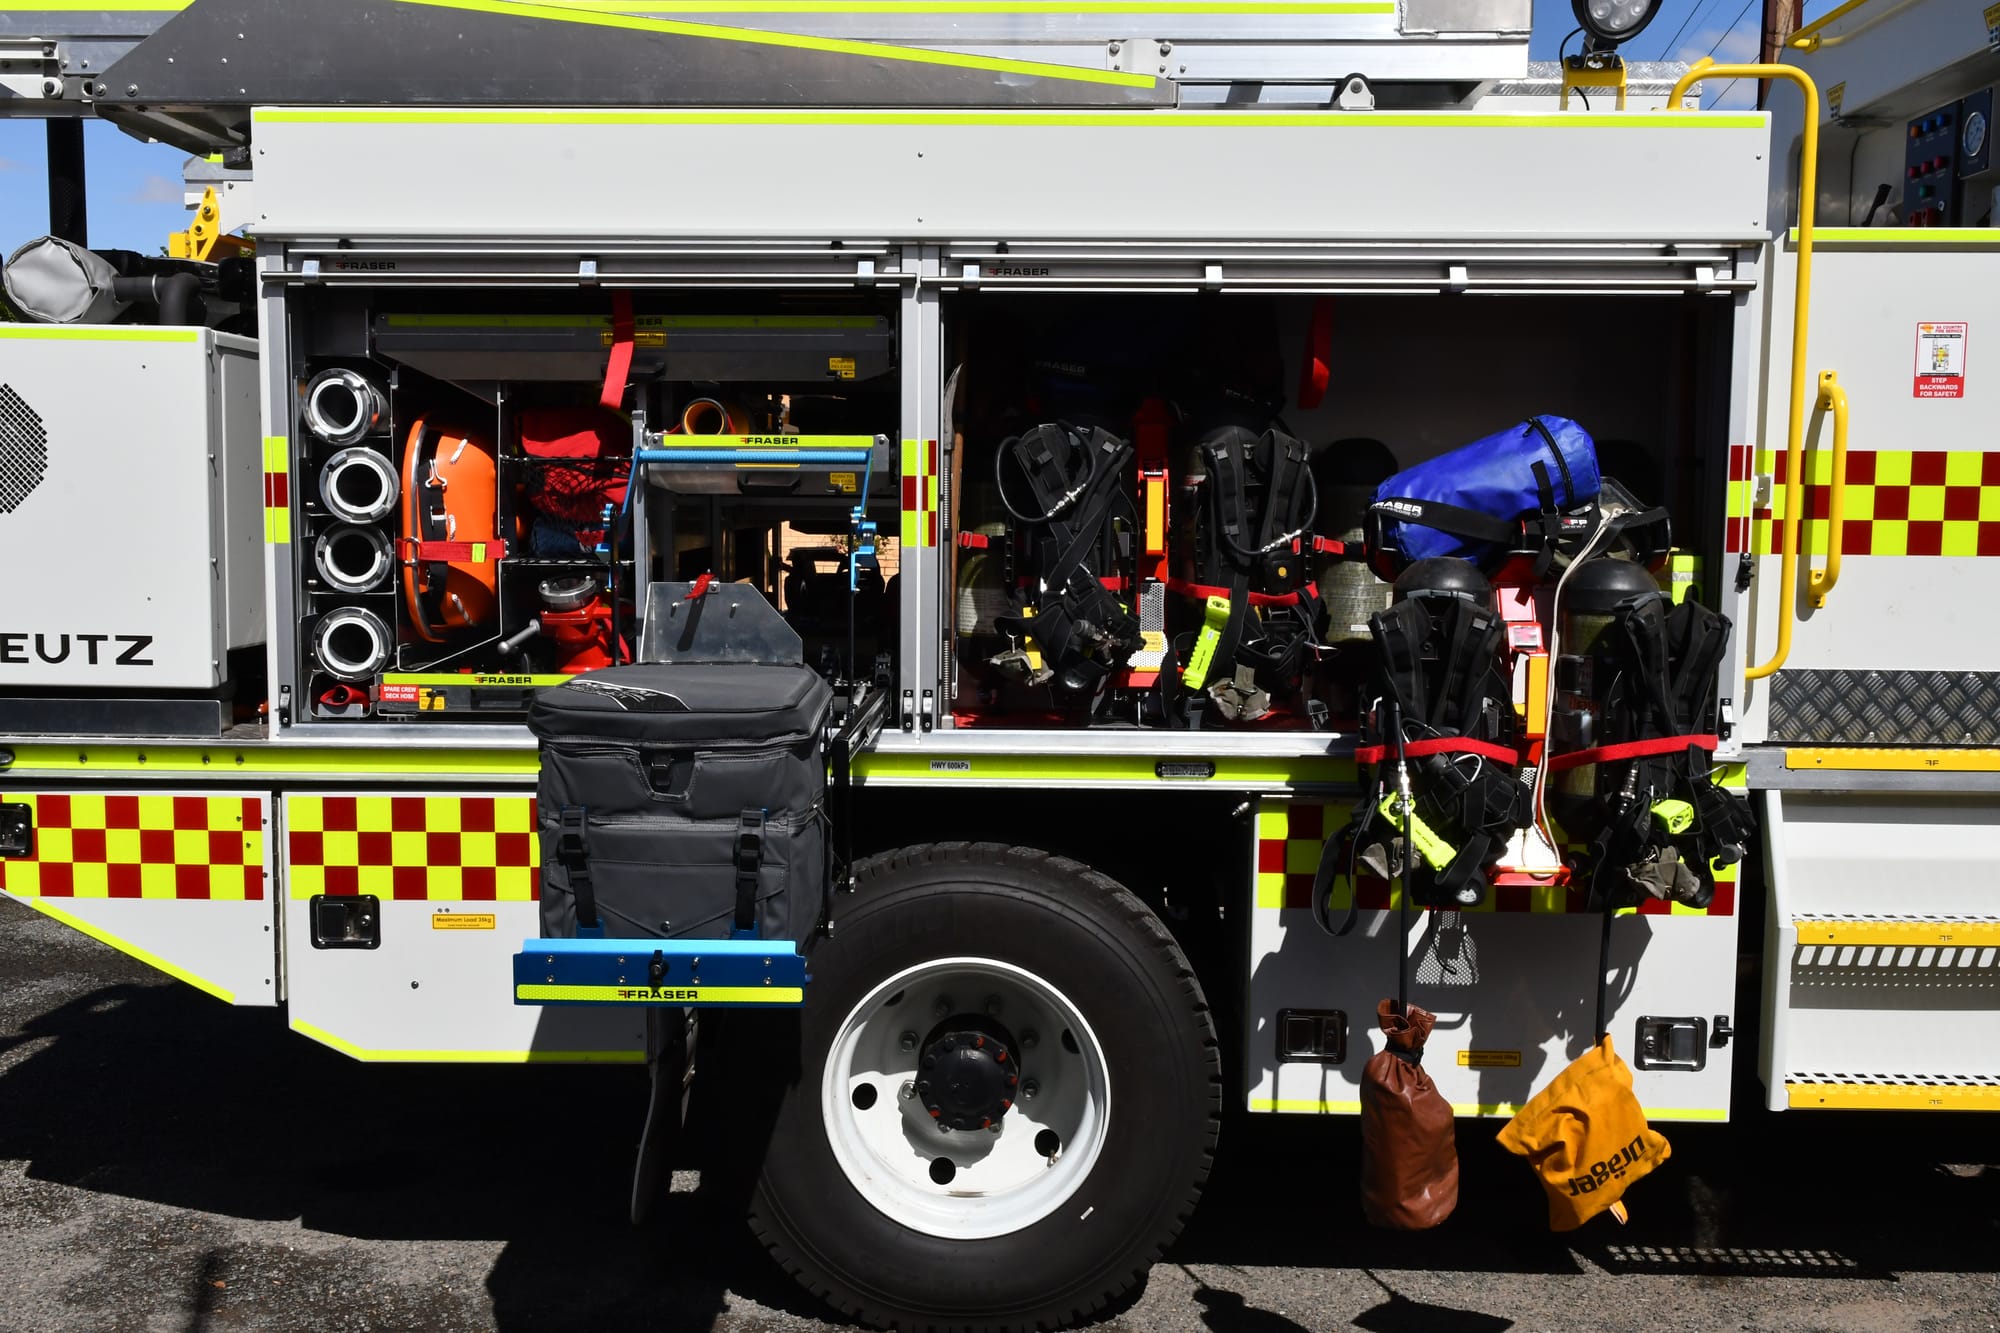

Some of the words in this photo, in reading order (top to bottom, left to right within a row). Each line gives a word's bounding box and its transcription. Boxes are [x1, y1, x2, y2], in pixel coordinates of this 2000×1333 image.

[996, 267, 1048, 276] FRASER
[747, 436, 798, 445] FRASER
[1373, 500, 1422, 514] RASER
[482, 676, 532, 684] FRASER
[931, 761, 946, 769] HWY
[627, 990, 699, 999] FRASER
